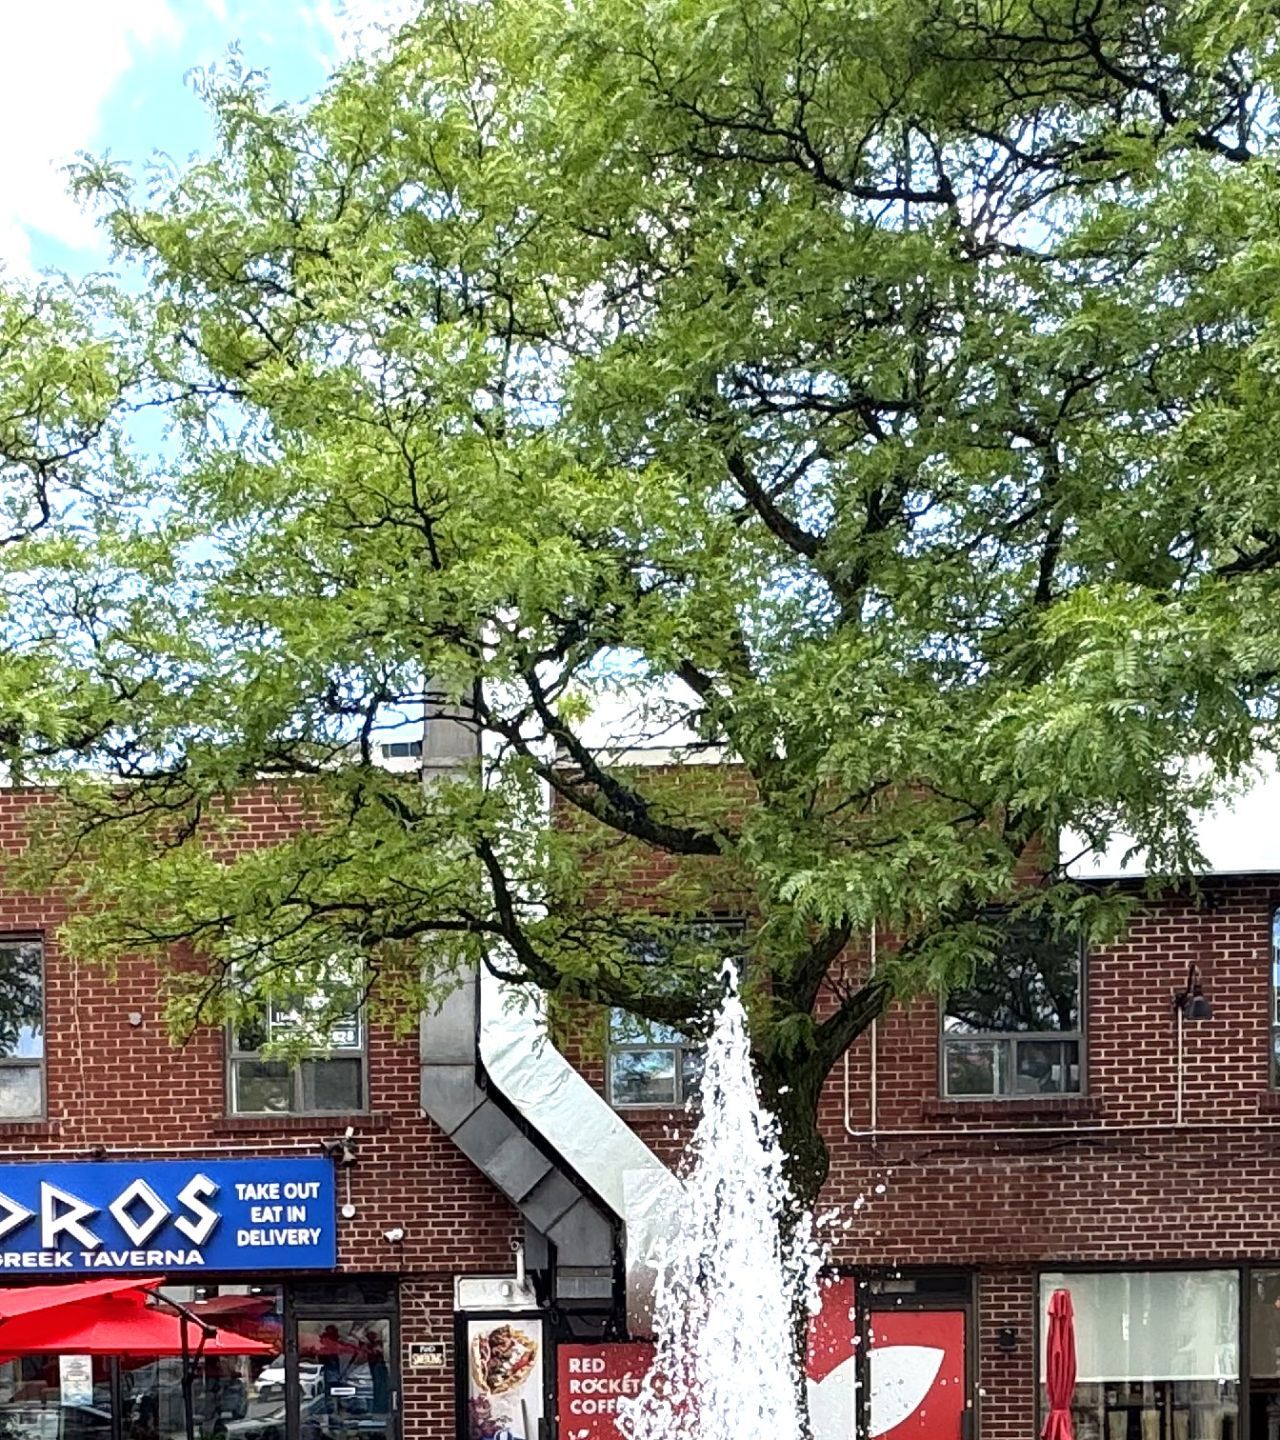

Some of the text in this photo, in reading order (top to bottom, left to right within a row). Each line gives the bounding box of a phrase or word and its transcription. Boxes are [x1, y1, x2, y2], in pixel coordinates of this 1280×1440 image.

[235, 1182, 320, 1201] TAKE OUT
[250, 1205, 306, 1222] EAT IN
[237, 1228, 321, 1246] DELIVERY
[80, 1249, 205, 1268] TAVERNA
[569, 1357, 605, 1374] RED
[570, 1377, 640, 1395] ROCKET
[570, 1399, 622, 1415] COFF
